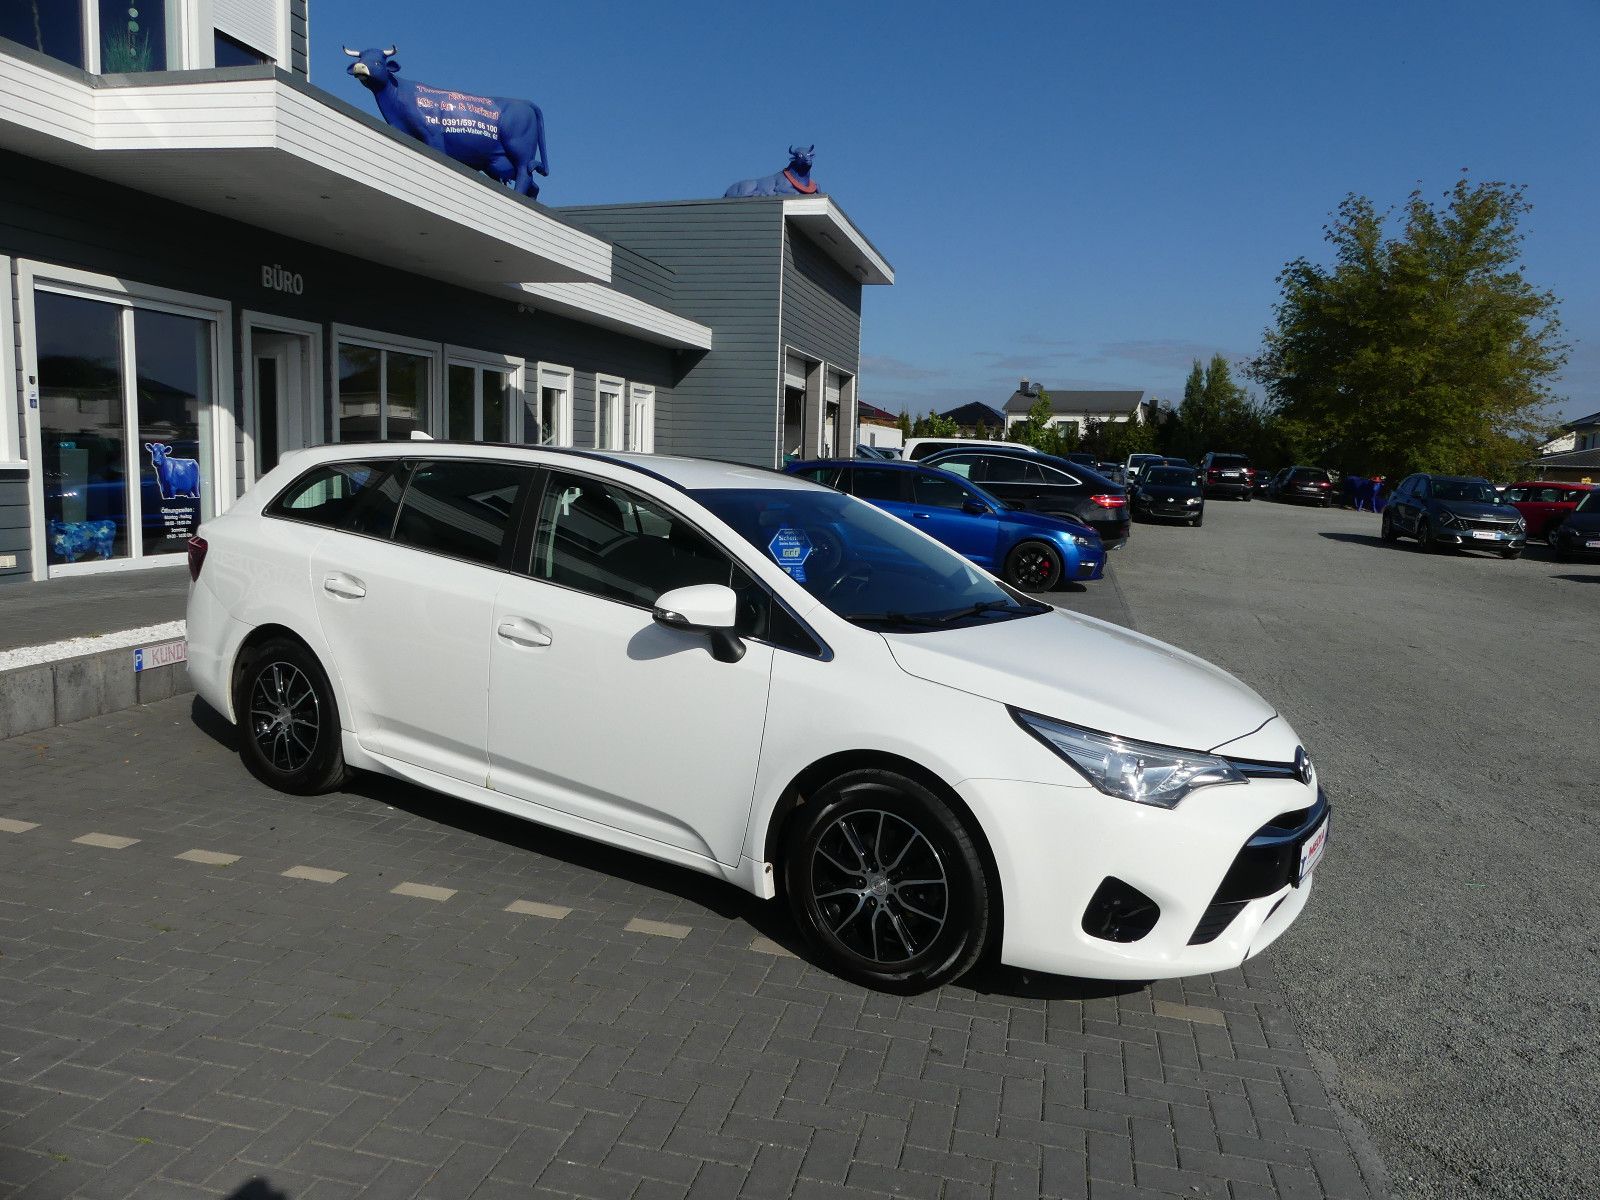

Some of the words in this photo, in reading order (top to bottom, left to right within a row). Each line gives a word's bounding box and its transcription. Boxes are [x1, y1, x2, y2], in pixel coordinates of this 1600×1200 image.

[426, 116, 440, 124] Tel.
[442, 118, 476, 126] 0391/597
[486, 124, 498, 133] 100
[261, 264, 304, 295] BÜRO
[136, 654, 142, 666] P
